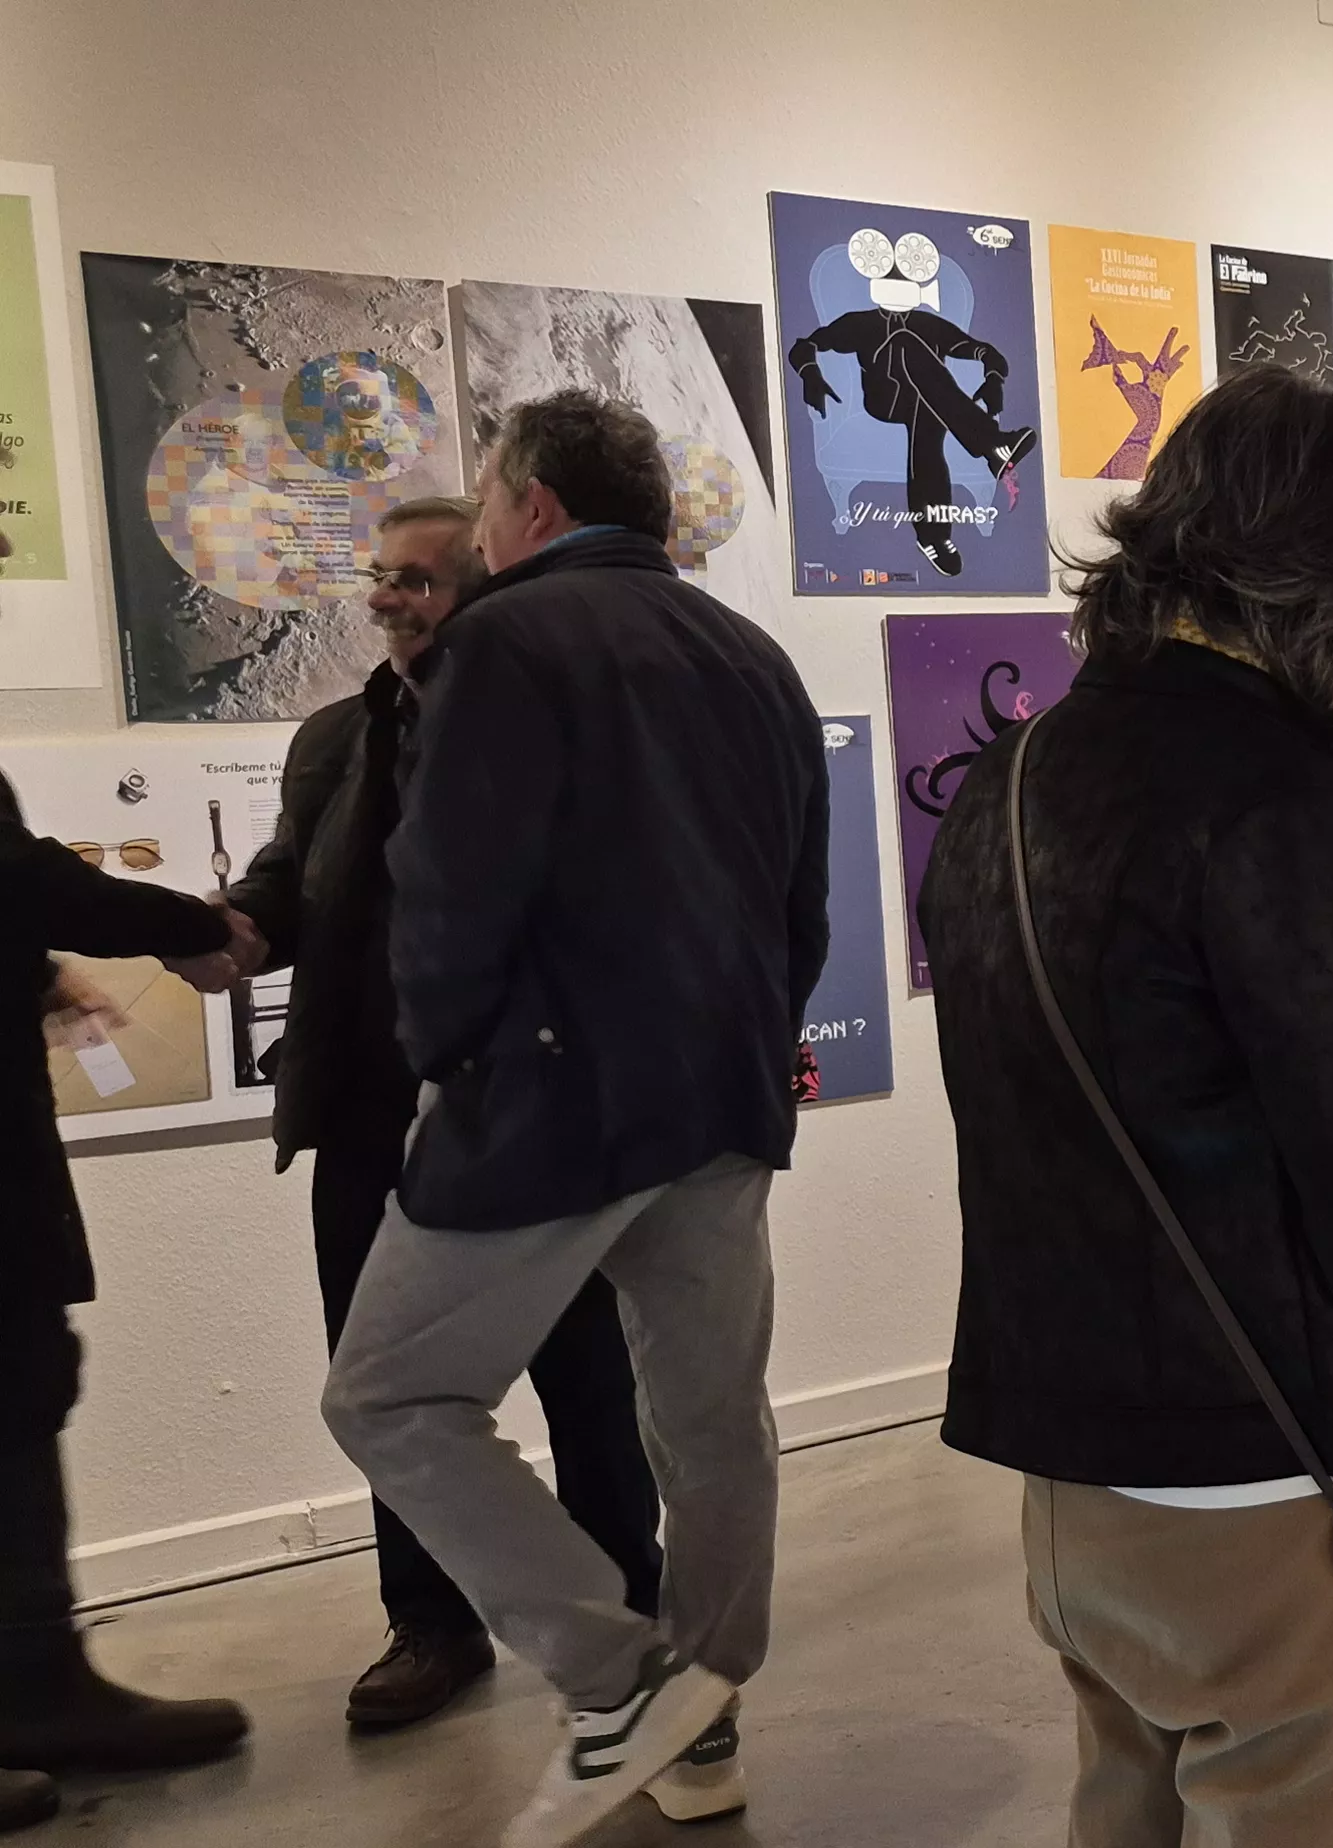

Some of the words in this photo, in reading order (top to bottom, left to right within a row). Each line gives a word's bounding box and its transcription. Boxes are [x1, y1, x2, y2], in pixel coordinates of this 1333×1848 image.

[181, 422, 195, 434] EL
[198, 420, 240, 436] HÉROE
[871, 504, 893, 523] tú
[892, 509, 925, 530] que
[926, 504, 999, 525] MIRAS?
[200, 761, 267, 774] "Escríbeme
[246, 775, 269, 786] que
